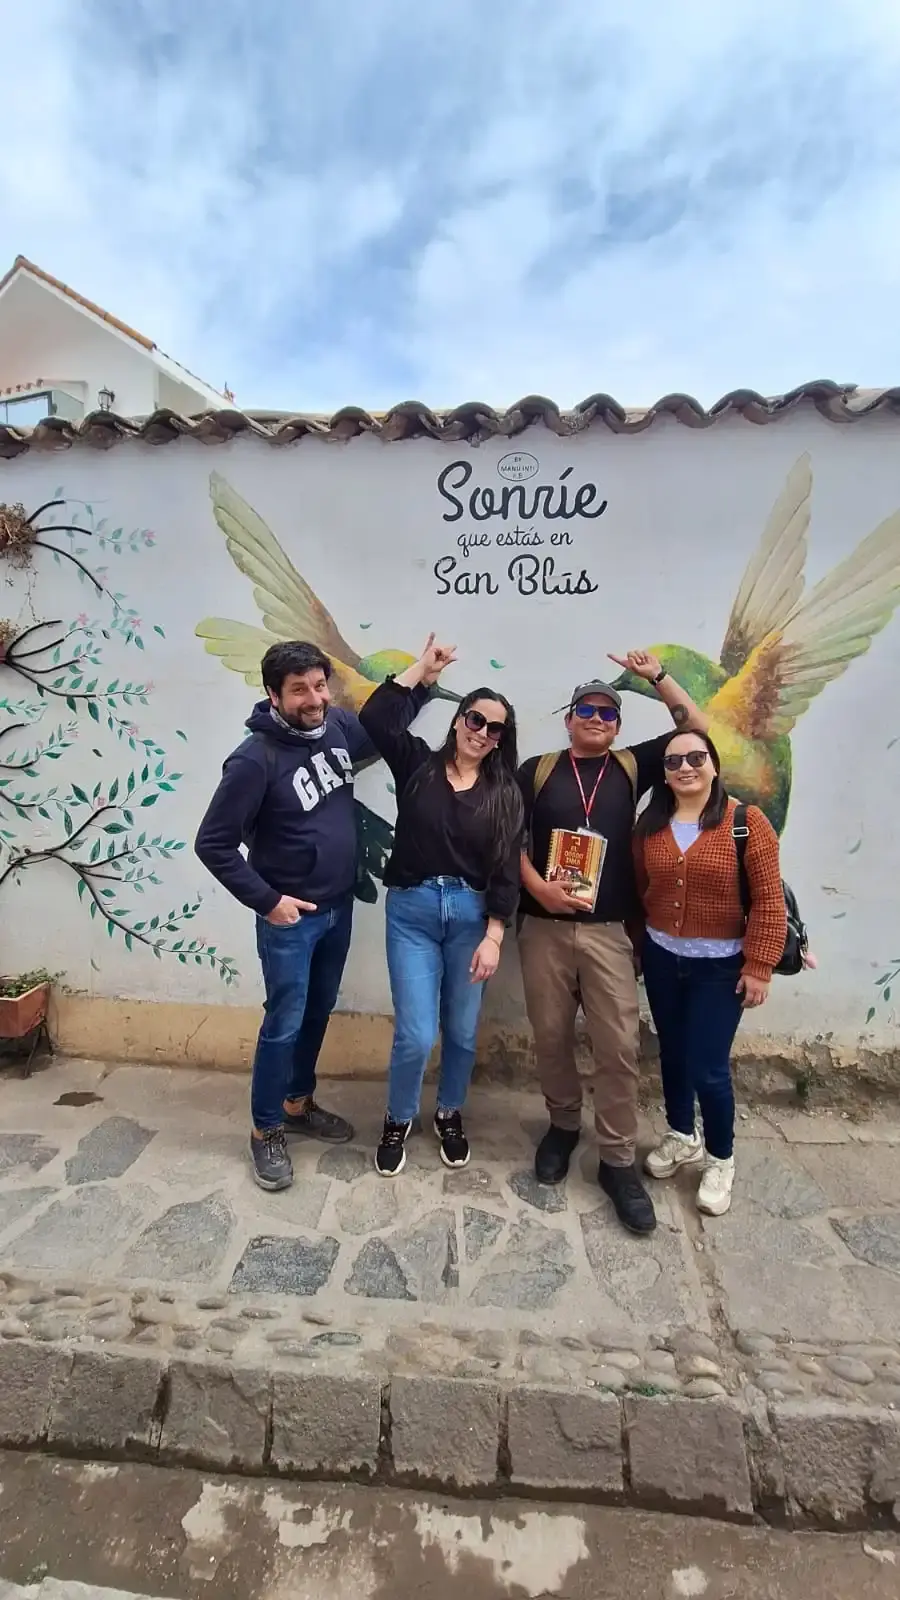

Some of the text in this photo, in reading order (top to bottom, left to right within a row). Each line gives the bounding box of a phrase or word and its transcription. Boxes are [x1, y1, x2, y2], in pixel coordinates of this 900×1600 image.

[438, 460, 608, 522] Sonríe
[457, 525, 573, 557] que estás en
[434, 556, 498, 595] San
[293, 748, 354, 811] GAP
